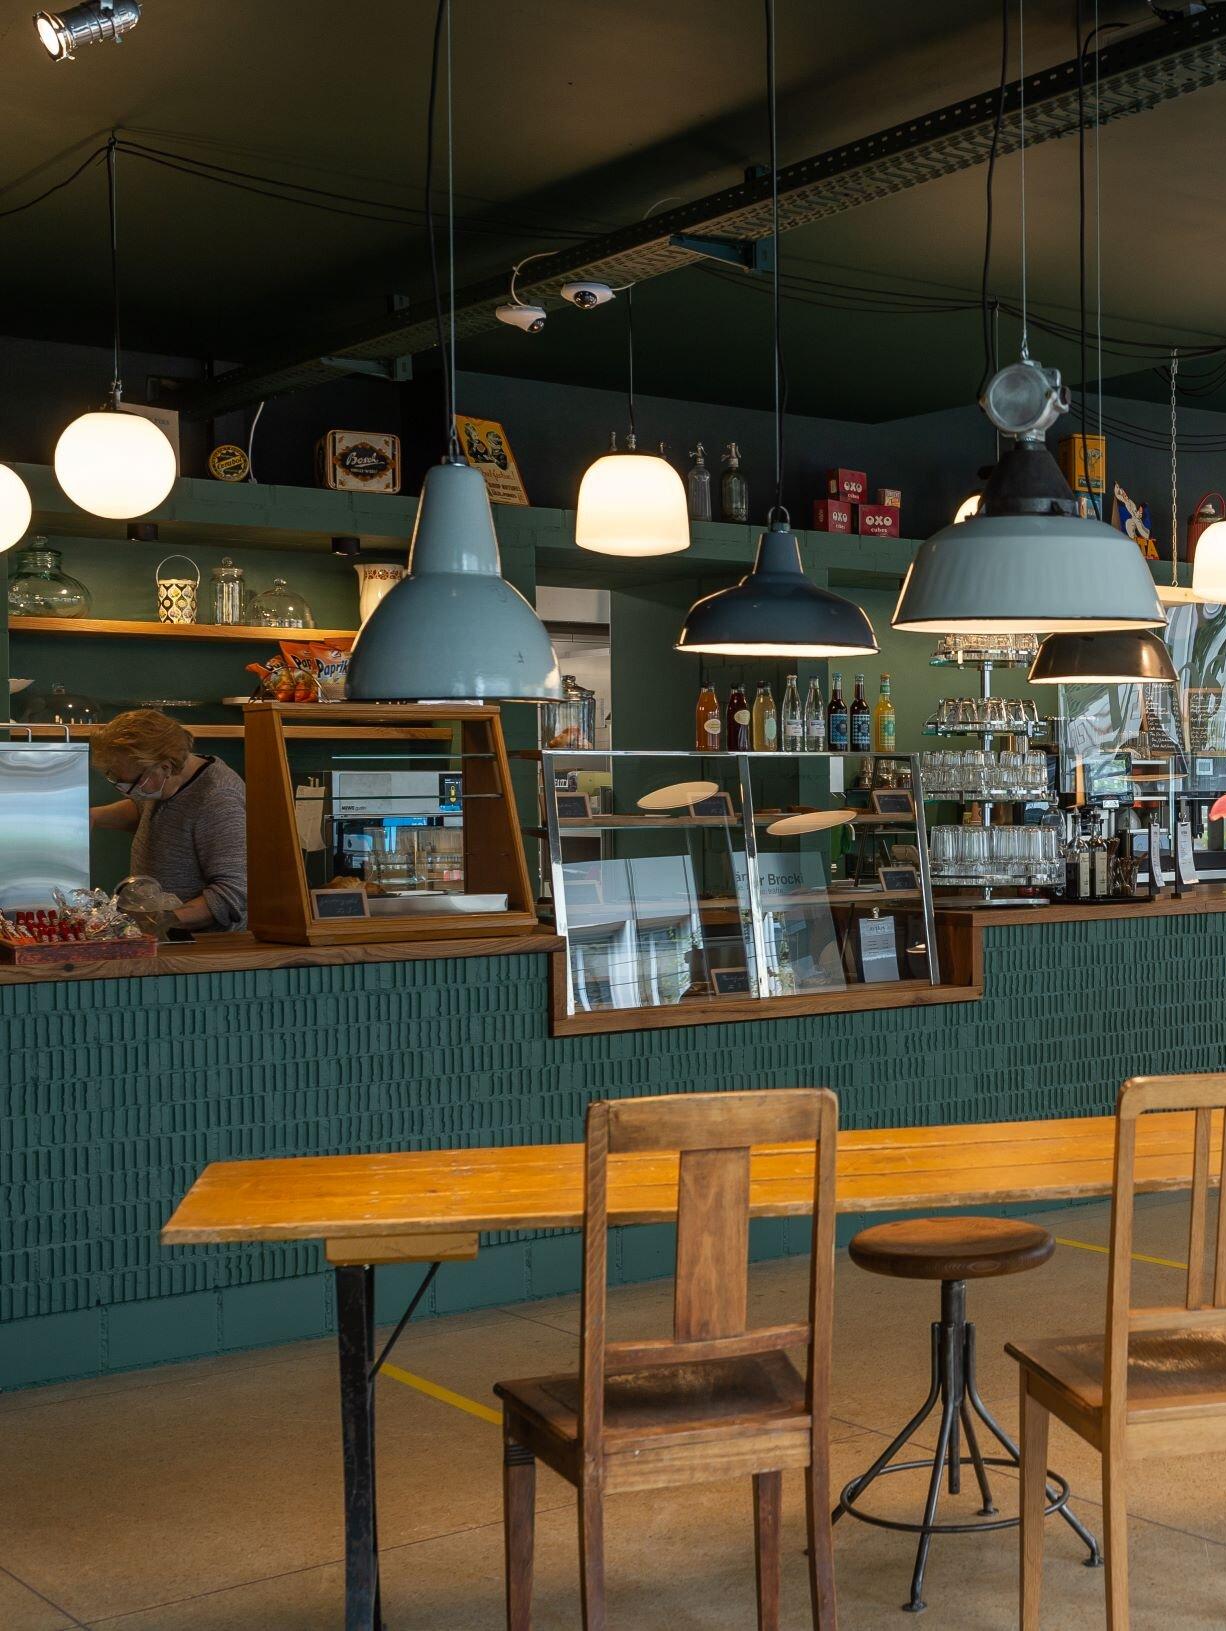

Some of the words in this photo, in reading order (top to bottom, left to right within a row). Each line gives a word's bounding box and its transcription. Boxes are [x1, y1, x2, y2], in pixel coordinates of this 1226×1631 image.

[843, 481, 863, 493] OXO
[832, 511, 848, 523] OXO
[865, 515, 893, 527] OXO
[870, 526, 888, 534] cubes
[315, 657, 351, 679] Paprik
